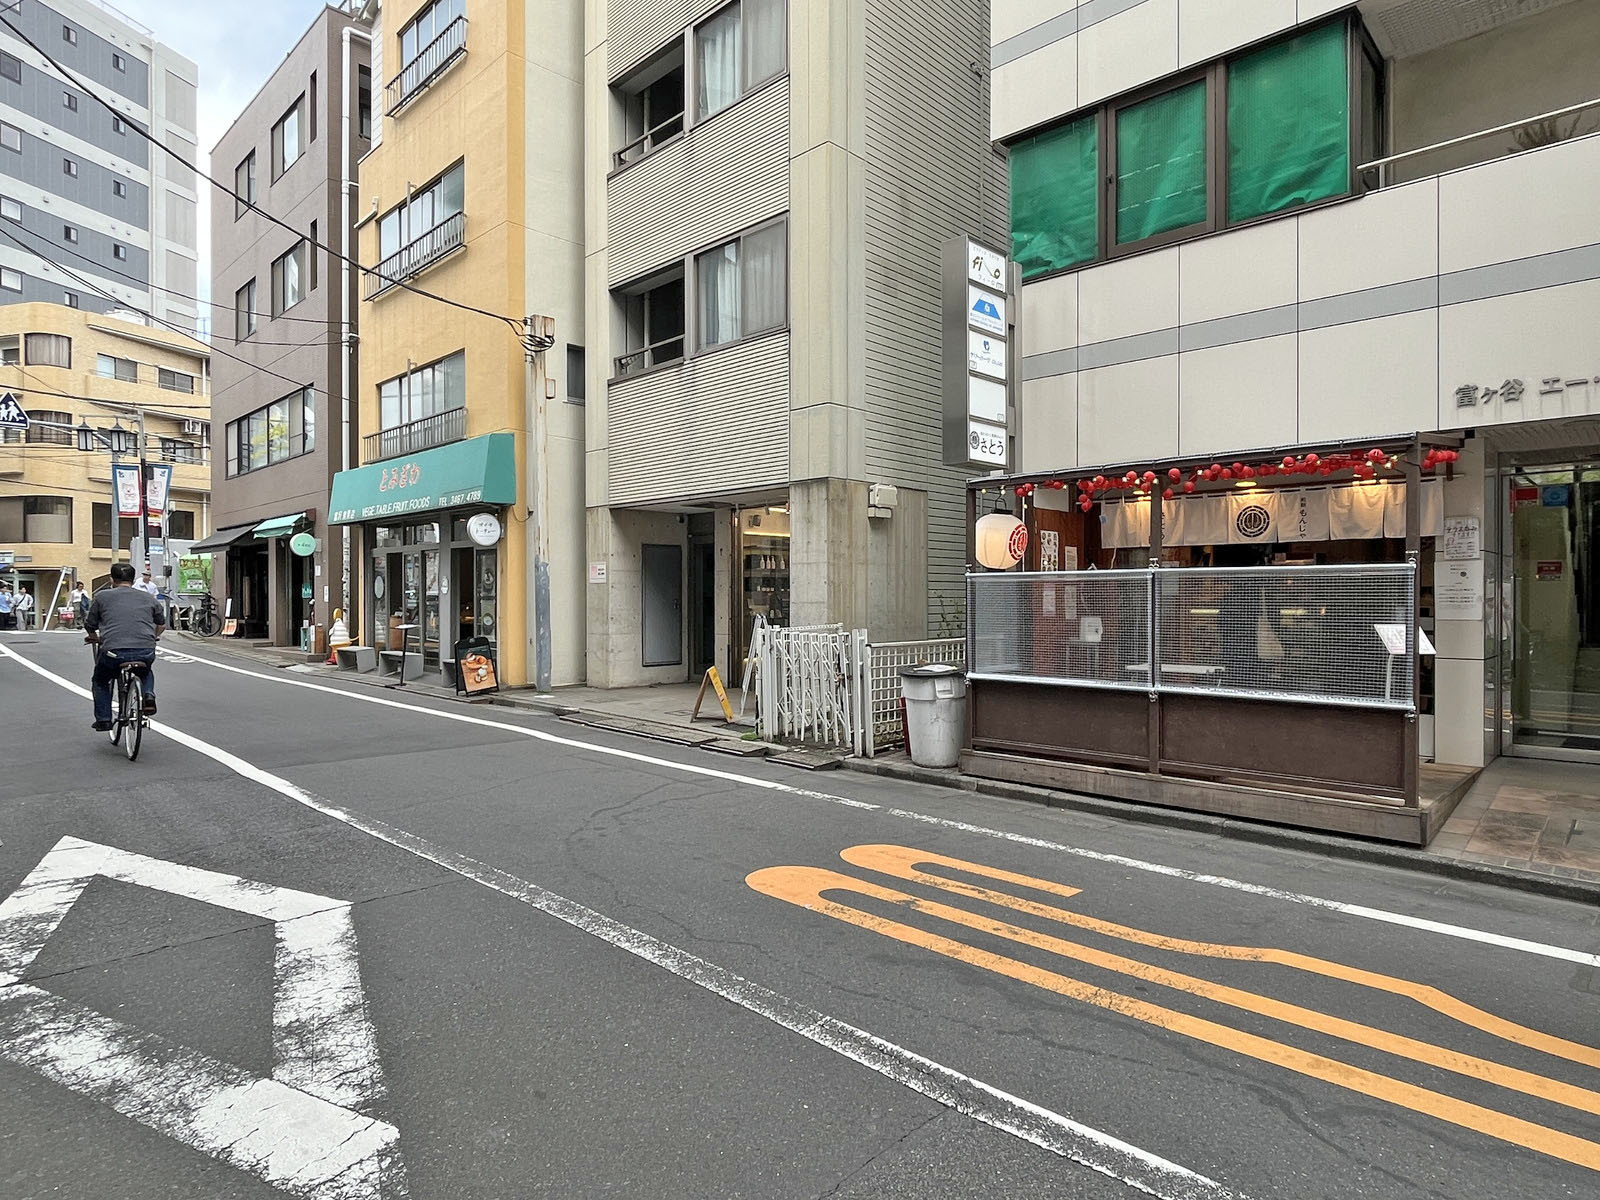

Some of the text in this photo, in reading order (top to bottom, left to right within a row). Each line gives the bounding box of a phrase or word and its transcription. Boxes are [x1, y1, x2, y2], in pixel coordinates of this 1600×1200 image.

[980, 437, 1004, 457] さとう
[379, 462, 423, 492] とみざわ
[438, 497, 448, 507] TEL
